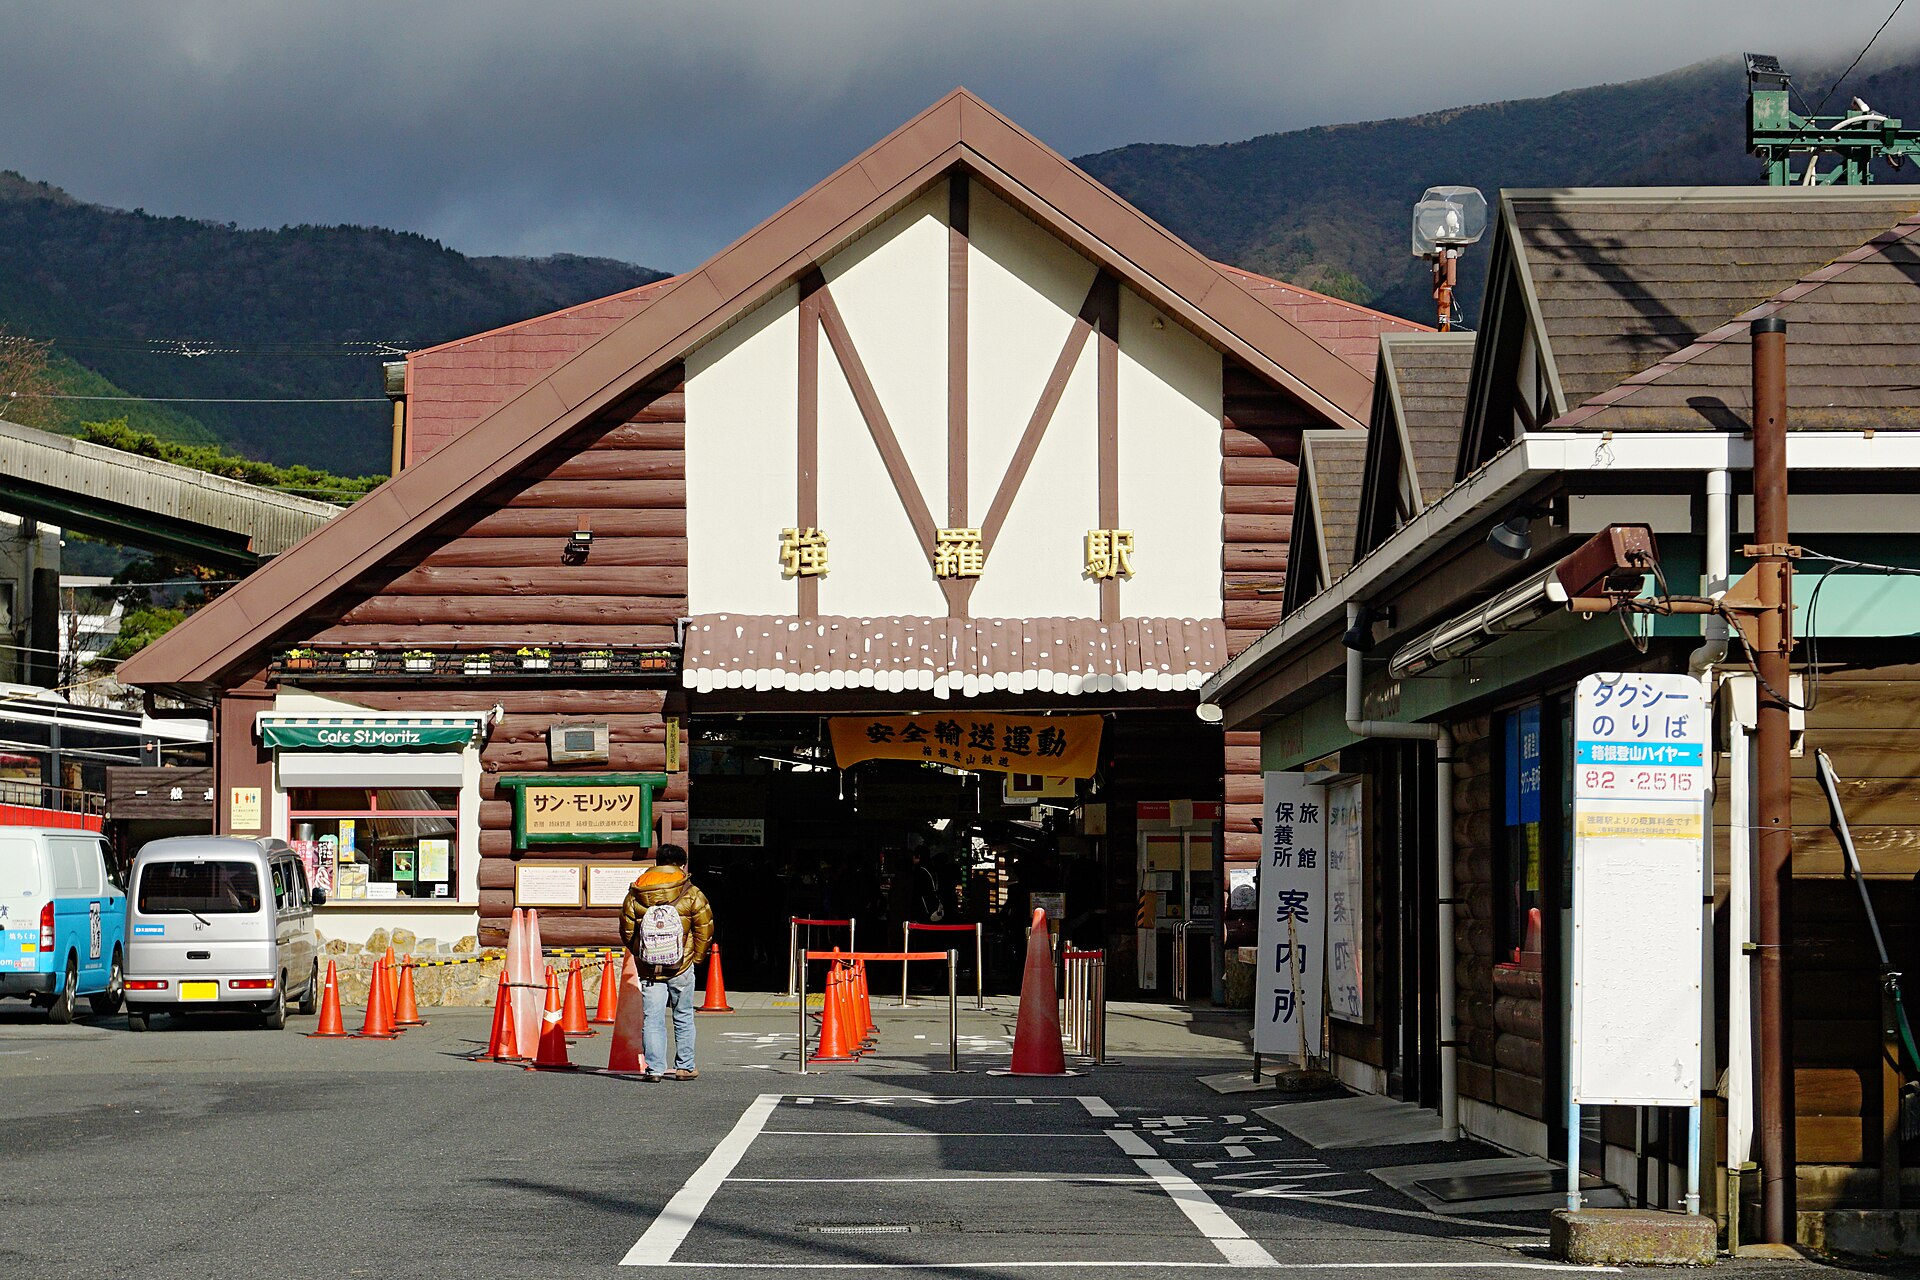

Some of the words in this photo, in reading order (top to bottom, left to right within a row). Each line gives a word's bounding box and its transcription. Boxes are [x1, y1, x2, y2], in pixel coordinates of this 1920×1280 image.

[780, 527, 1136, 579] 強羅駅
[1592, 682, 1690, 708] タクシー
[353, 730, 421, 744] St.Moritz
[865, 719, 1068, 758] 安全輸送運動
[1592, 714, 1690, 738] のりば
[922, 745, 1010, 768] 箱根登山鉄道
[1591, 745, 1691, 763] 箱根登山ハイヤー
[1585, 770, 1616, 790] 82
[533, 794, 634, 813] サン・モリッツ
[1272, 801, 1294, 869] 保養所
[1297, 802, 1320, 870] 旅館
[1271, 888, 1310, 1025] 案内所
